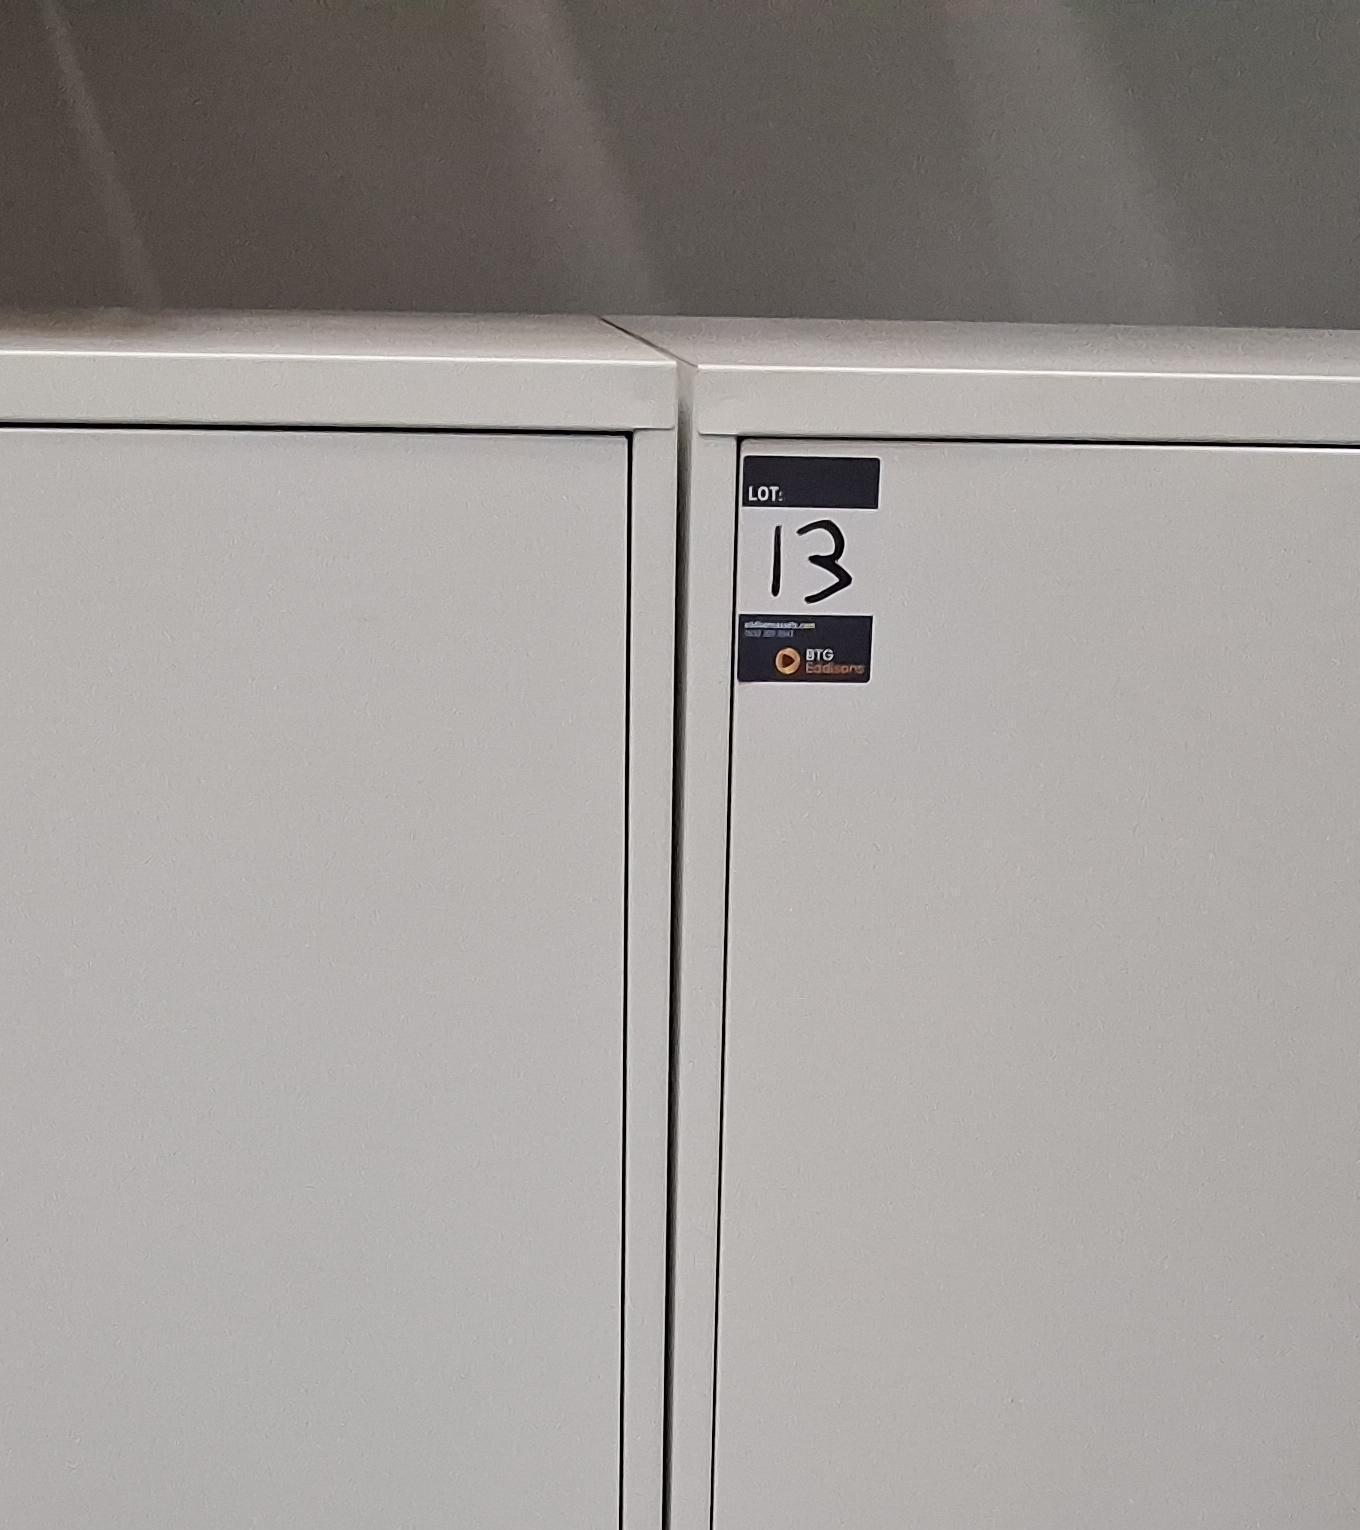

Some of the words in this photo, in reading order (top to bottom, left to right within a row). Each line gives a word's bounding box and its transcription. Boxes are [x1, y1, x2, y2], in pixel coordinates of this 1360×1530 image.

[748, 485, 783, 502] LOT:
[771, 519, 853, 604] 13
[805, 648, 835, 661] BTG
